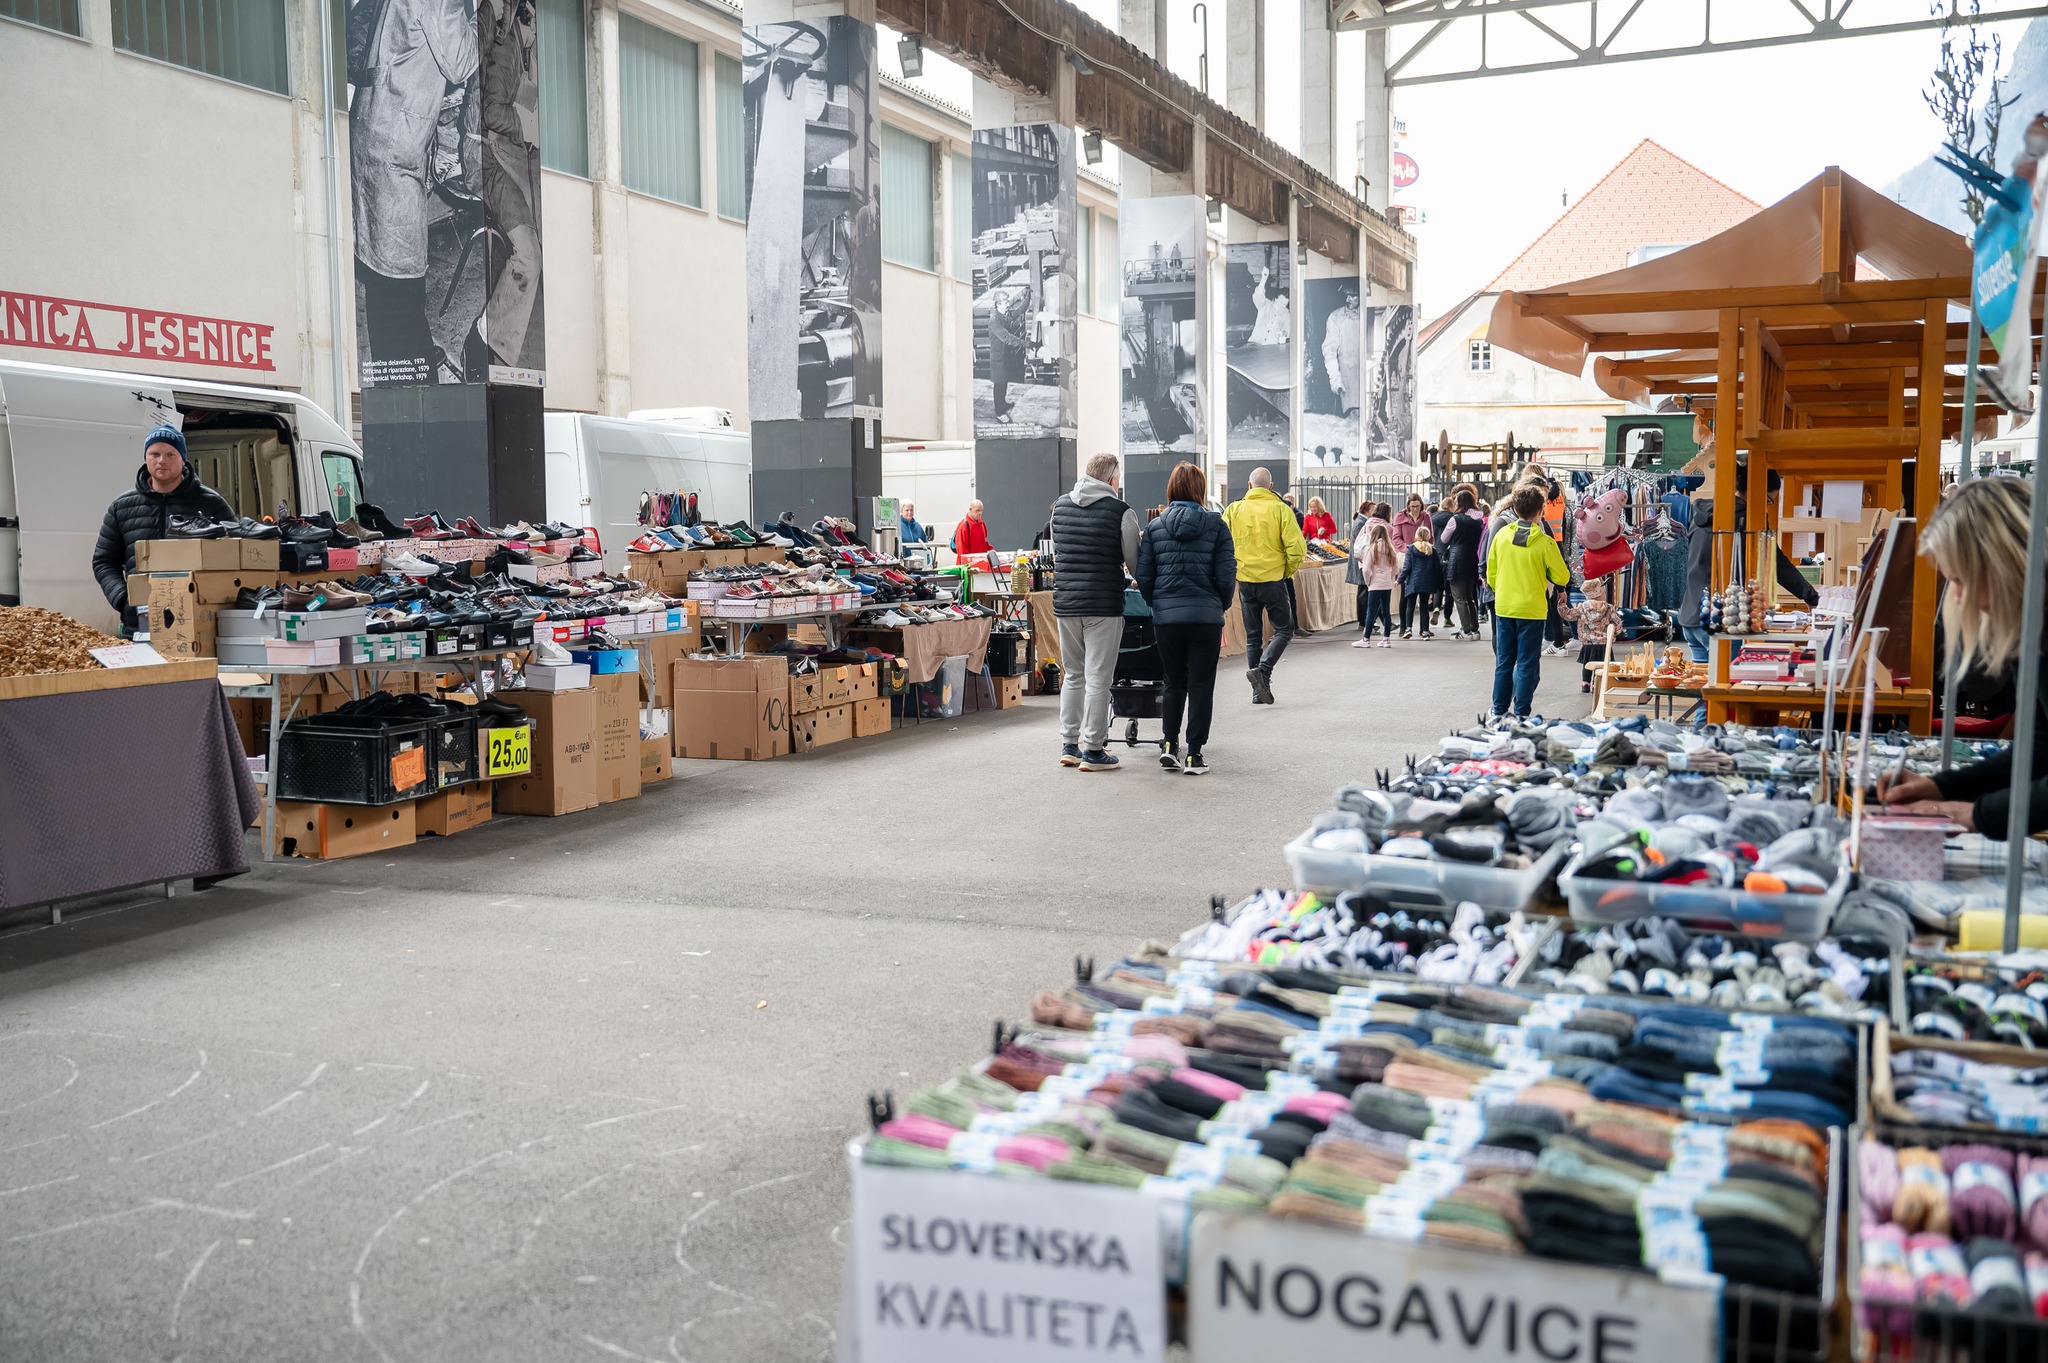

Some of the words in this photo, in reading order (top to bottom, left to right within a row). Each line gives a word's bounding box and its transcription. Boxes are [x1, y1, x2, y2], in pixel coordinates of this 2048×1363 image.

[117, 310, 275, 369] JESENICE
[413, 357, 426, 365] 1979
[388, 366, 417, 374] riparazione,
[492, 739, 529, 771] 25,00
[881, 1213, 1132, 1274] SLOVENSKA
[874, 1281, 1143, 1355] KVALITETA
[1216, 1255, 1638, 1363] NOGAVICE
